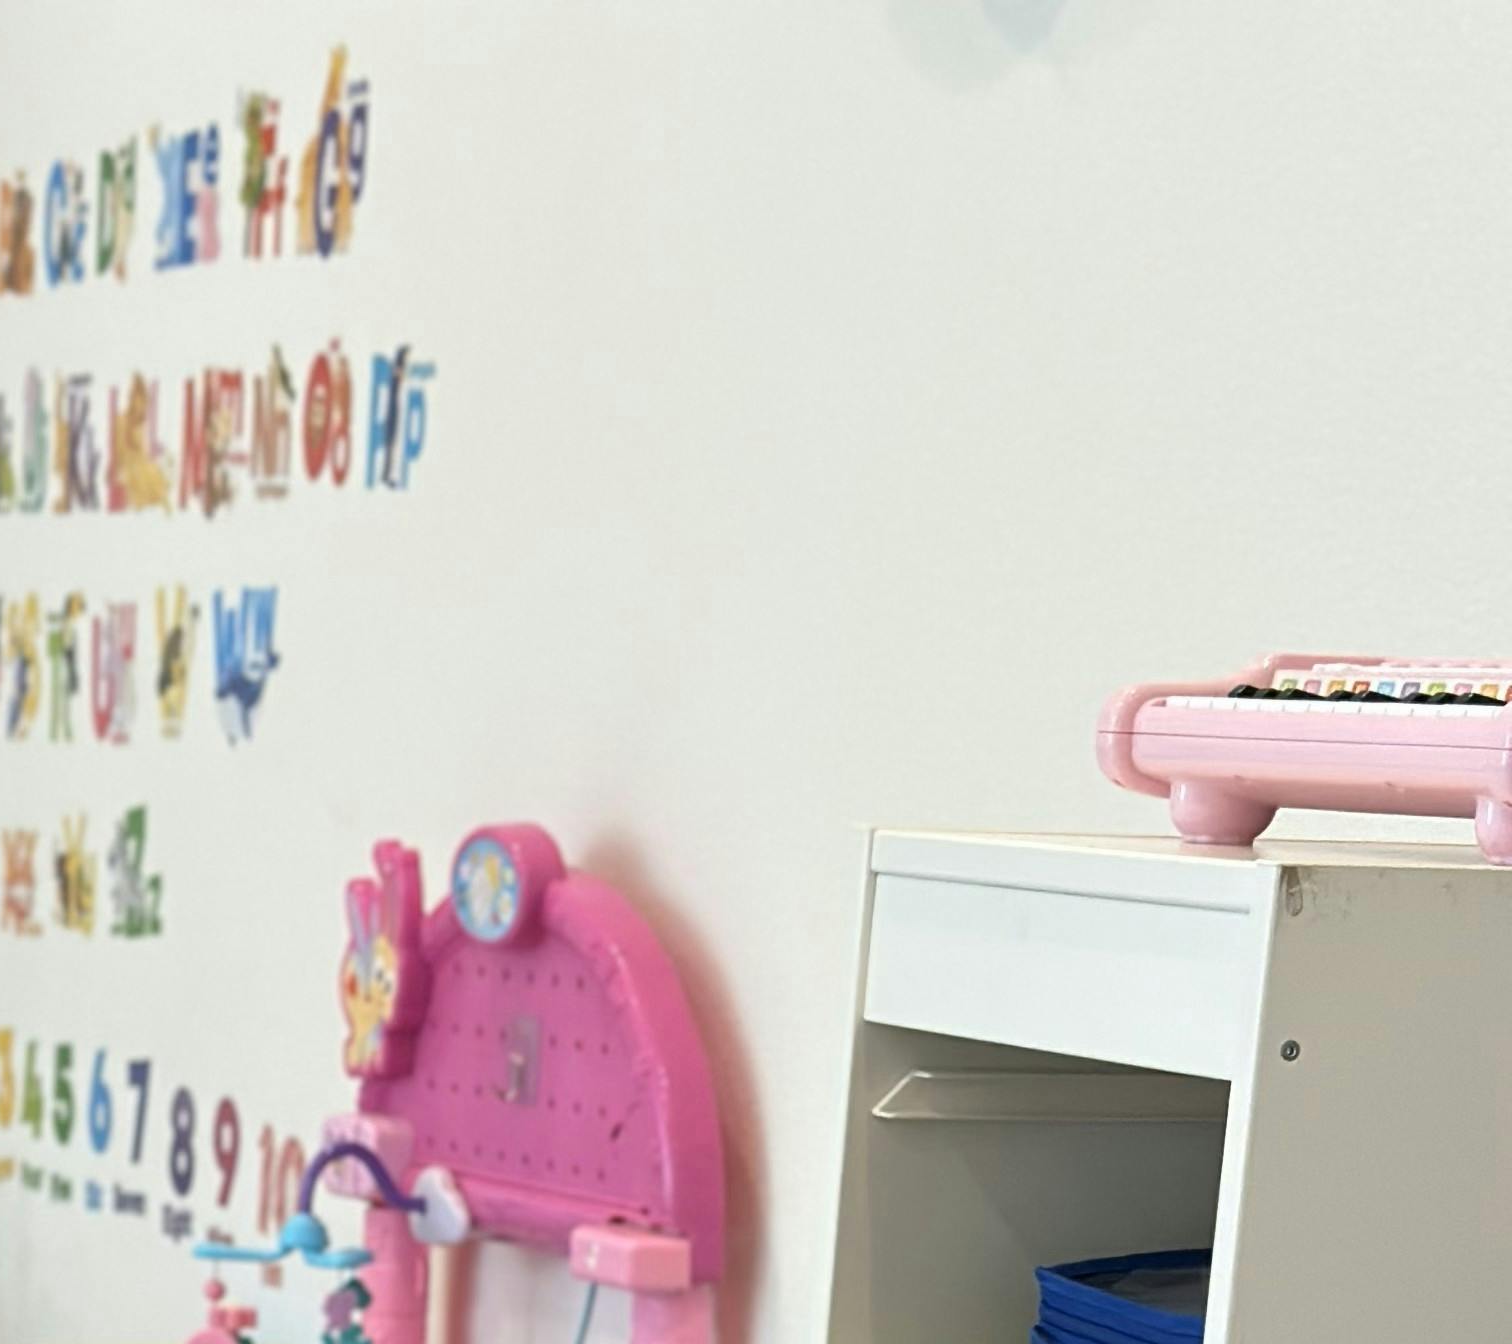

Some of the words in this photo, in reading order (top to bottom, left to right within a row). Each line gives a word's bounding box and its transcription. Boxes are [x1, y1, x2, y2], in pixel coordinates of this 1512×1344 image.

[20, 1040, 44, 1139] 4
[52, 1043, 75, 1146] 5
[88, 1048, 113, 1154] 6
[128, 1058, 152, 1165] 7
[169, 1086, 196, 1197] 8
[213, 1097, 241, 1208] 9
